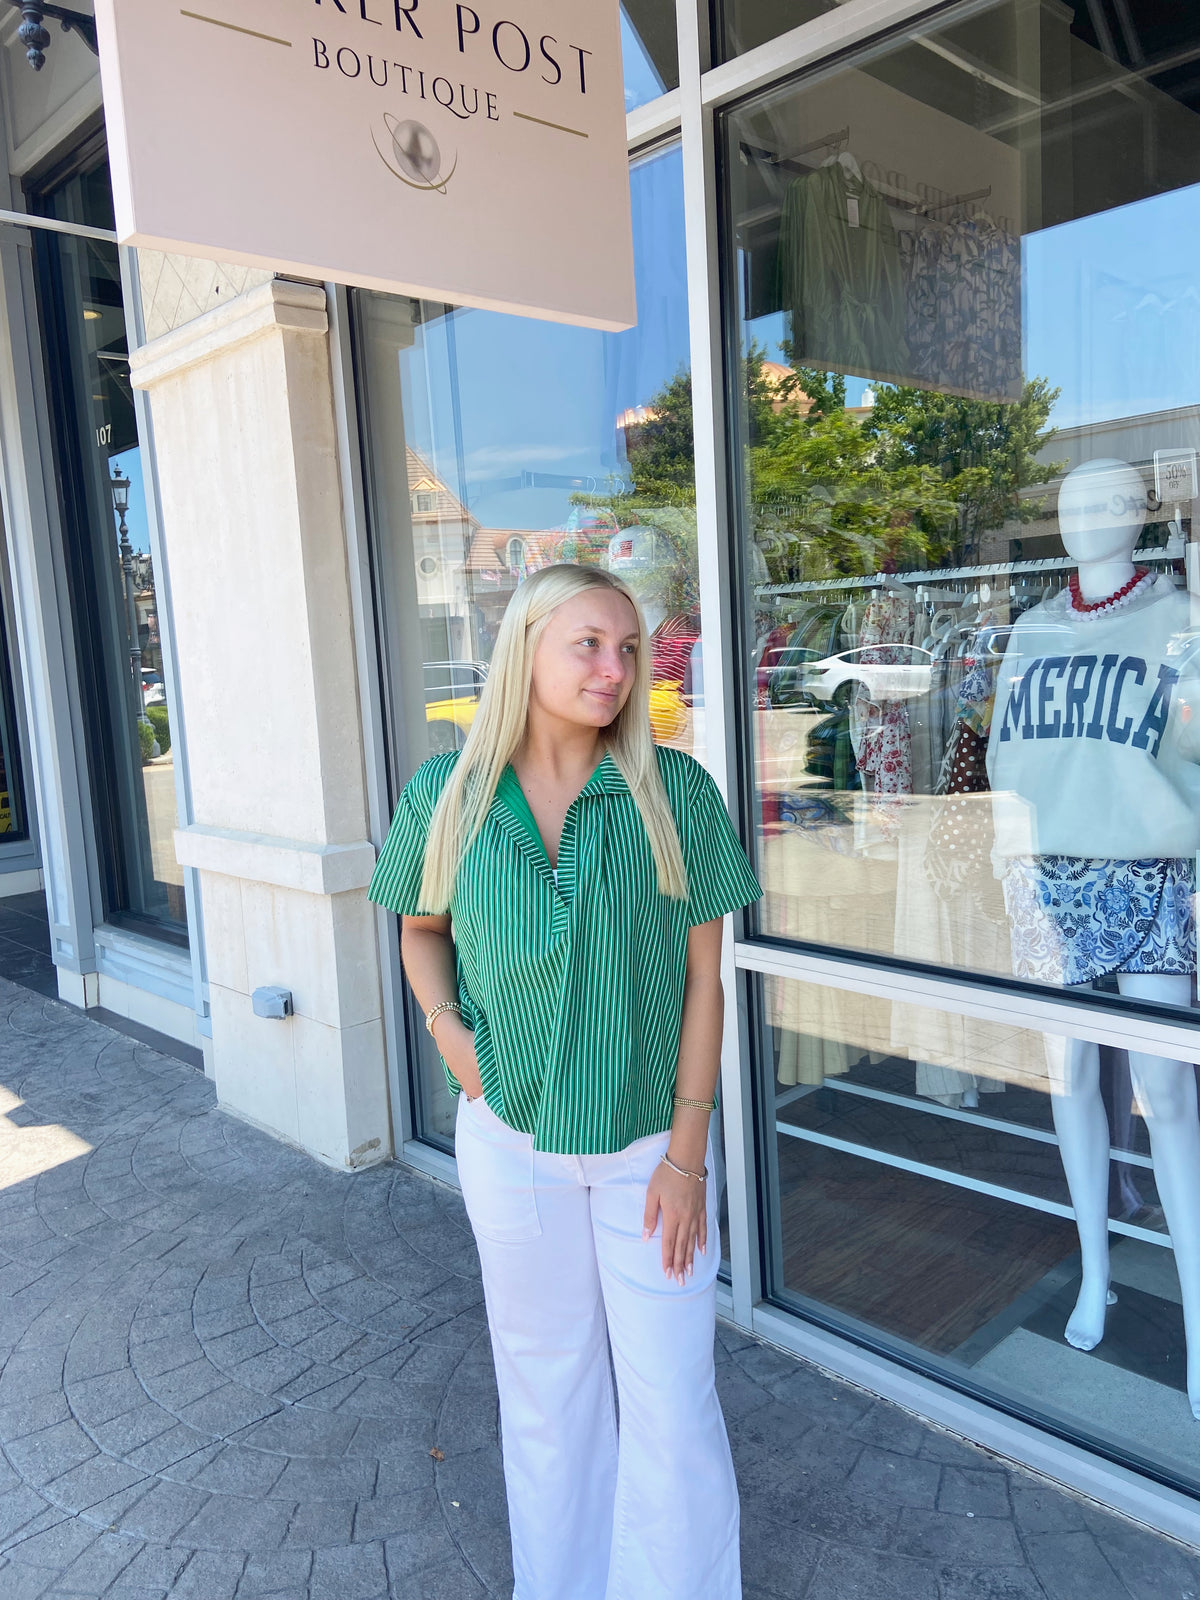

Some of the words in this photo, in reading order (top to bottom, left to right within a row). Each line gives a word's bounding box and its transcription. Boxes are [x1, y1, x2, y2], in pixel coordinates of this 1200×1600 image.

[312, 37, 500, 121] BOUTIQUE
[456, 4, 592, 94] POST
[96, 424, 111, 447] 107
[1000, 654, 1180, 759] MERICA
